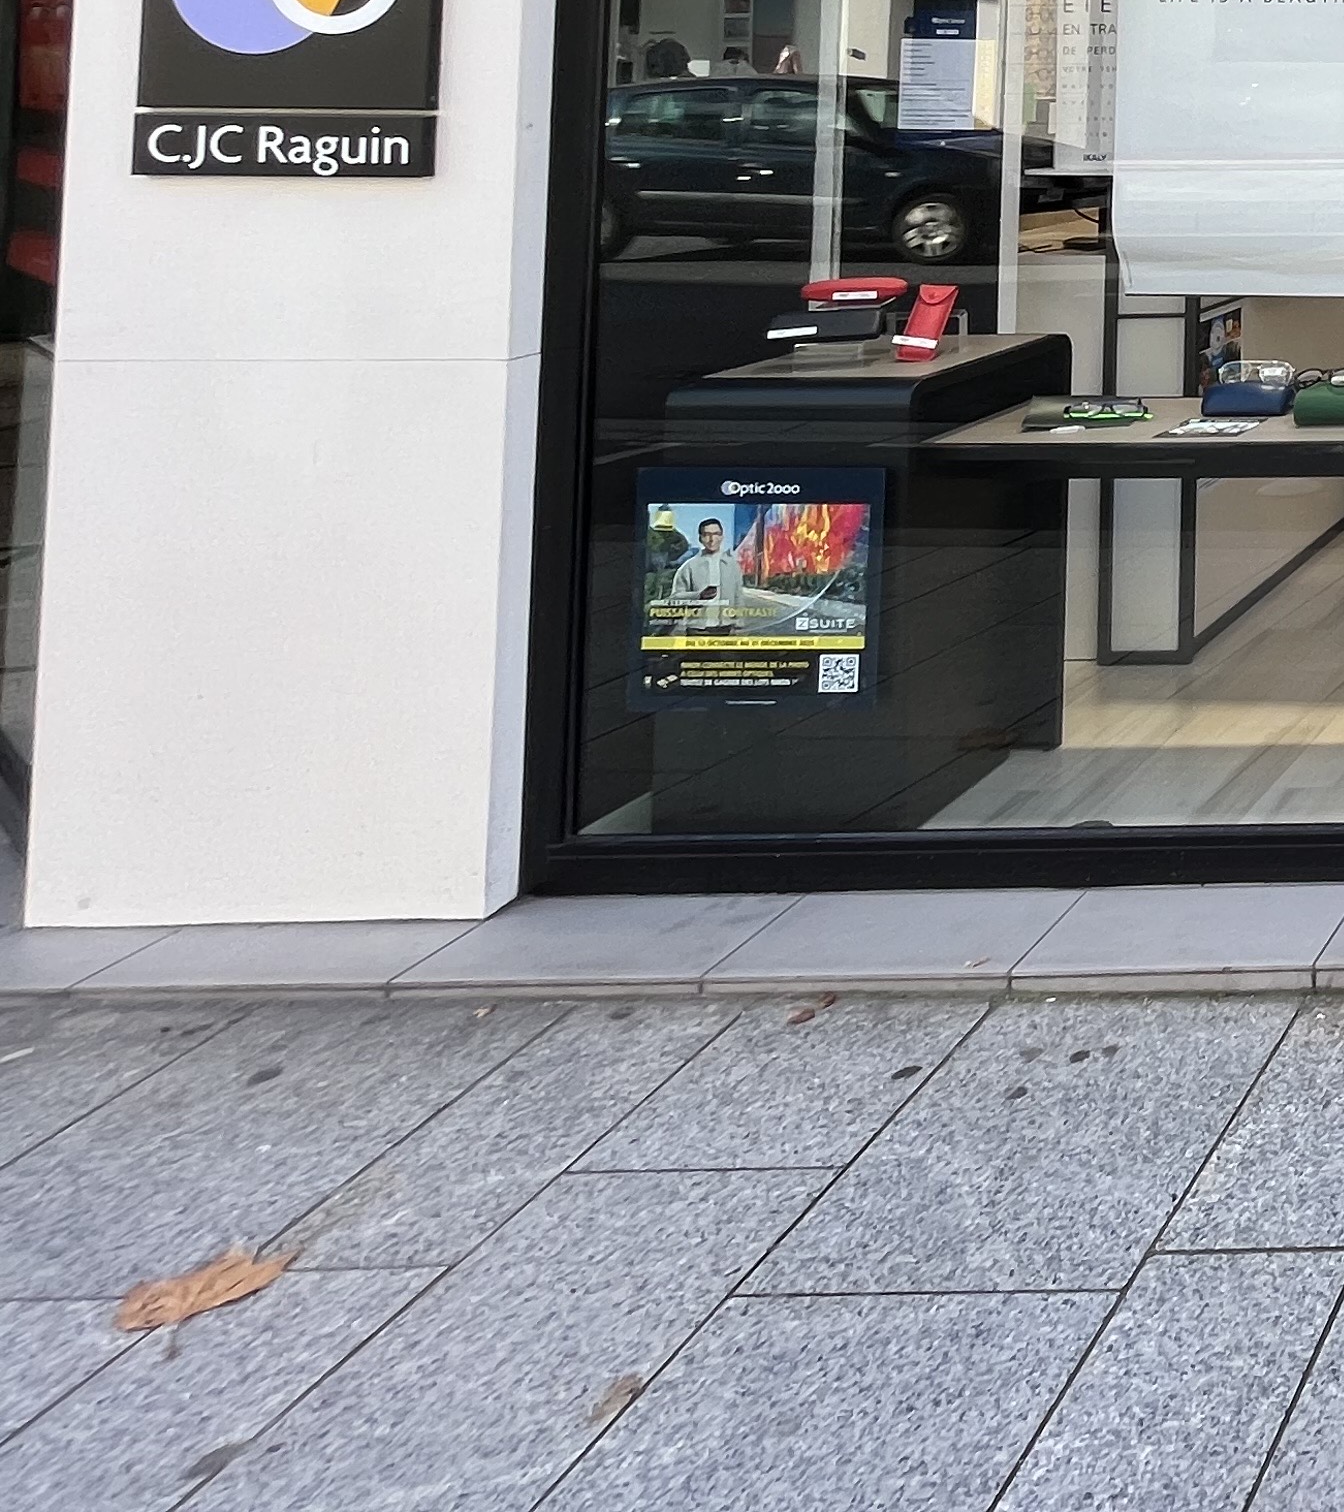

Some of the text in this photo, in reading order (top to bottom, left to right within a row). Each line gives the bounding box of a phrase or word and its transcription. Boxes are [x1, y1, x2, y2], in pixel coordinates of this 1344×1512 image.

[1062, 23, 1081, 36] EN
[147, 123, 410, 177] C.JC Raguin
[727, 481, 801, 498] Optic 2000
[809, 618, 856, 630] SUITE
